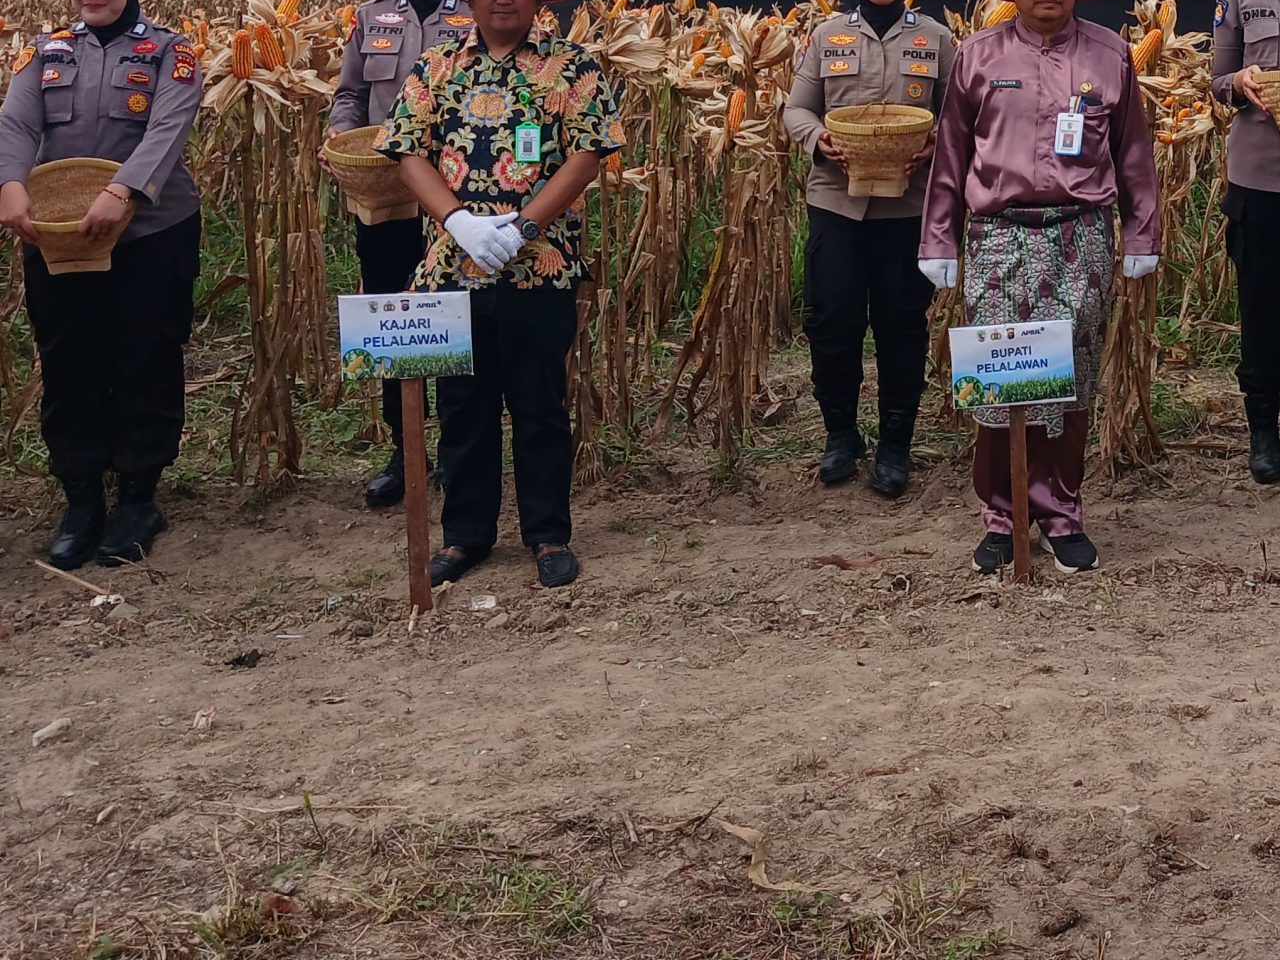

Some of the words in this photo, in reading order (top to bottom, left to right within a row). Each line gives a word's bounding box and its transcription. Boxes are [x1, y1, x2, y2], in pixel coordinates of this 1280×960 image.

[1242, 8, 1277, 22] DHEA
[368, 25, 404, 36] FITRI
[823, 48, 857, 58] DILLA
[902, 49, 937, 61] POLRI
[379, 317, 432, 332] KAJARI
[363, 330, 450, 349] PELALAWAN
[990, 345, 1033, 360] BUPATI
[976, 358, 1049, 375] PELALAWAN
